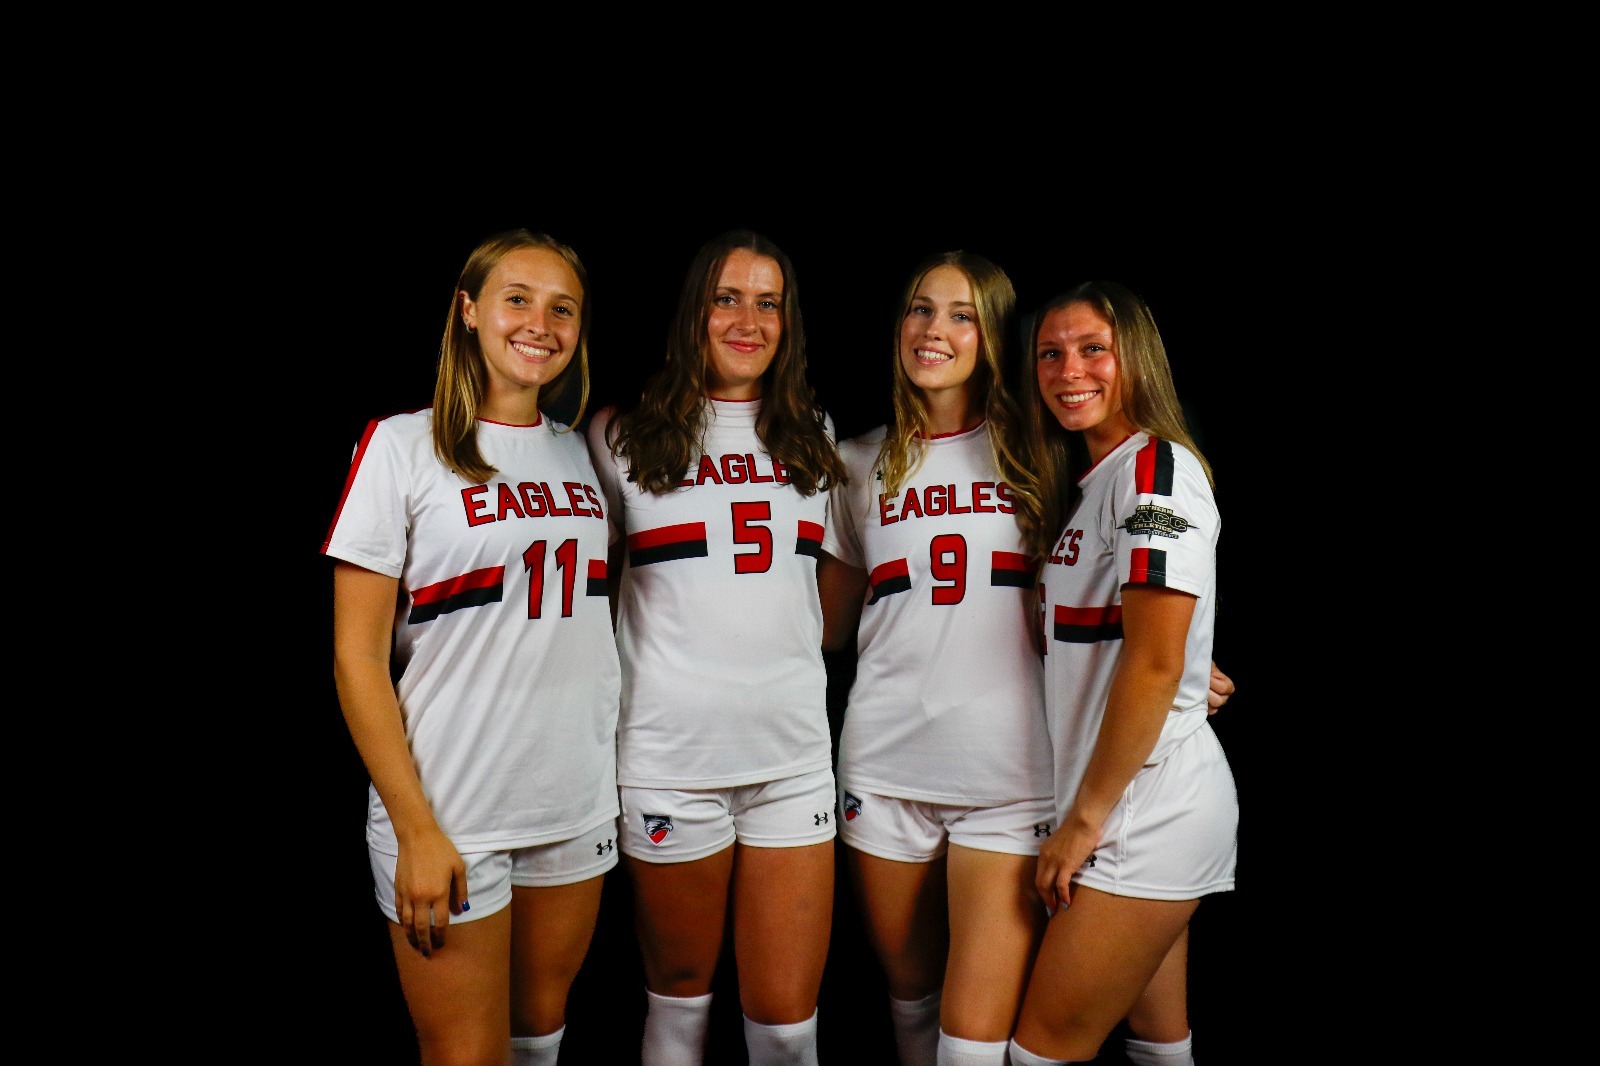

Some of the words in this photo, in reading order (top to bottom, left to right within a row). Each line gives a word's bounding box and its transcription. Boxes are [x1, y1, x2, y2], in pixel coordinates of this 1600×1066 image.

[677, 454, 792, 487] AGLE
[461, 482, 604, 527] EAGLES
[879, 482, 1017, 527] EAGLES
[1127, 511, 1188, 531] ACC
[731, 501, 773, 575] 5
[1047, 529, 1084, 566] ES
[1131, 523, 1173, 533] THLETICS
[522, 538, 578, 620] 11
[930, 533, 968, 606] 9
